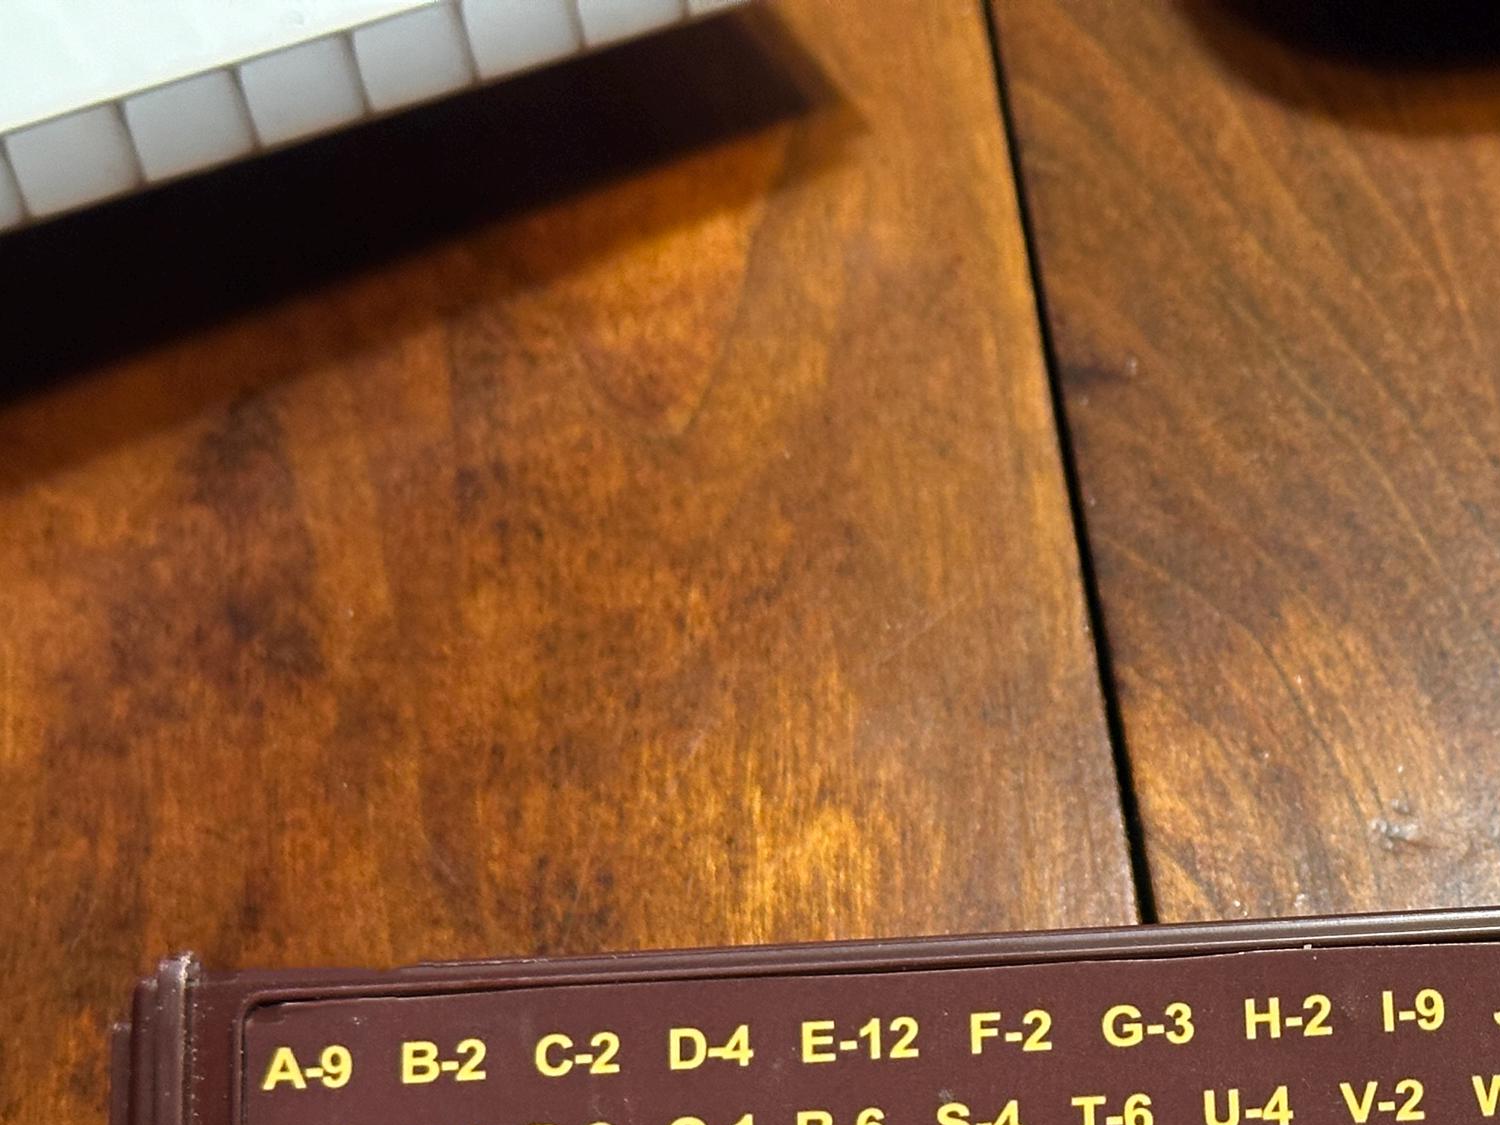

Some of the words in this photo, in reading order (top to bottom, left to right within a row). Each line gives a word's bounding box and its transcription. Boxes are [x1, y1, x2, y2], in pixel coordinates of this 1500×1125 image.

[263, 1045, 352, 1089] A-9
[401, 1039, 485, 1084] B-2
[534, 1032, 619, 1077] C-2
[669, 1025, 752, 1070] D-4
[802, 1017, 918, 1063] E-12
[970, 1010, 1051, 1052] F-2
[1102, 1003, 1194, 1047] G-3
[1245, 995, 1331, 1038] H-2
[1383, 989, 1444, 1031] I-9
[1340, 1079, 1424, 1123] V-2
